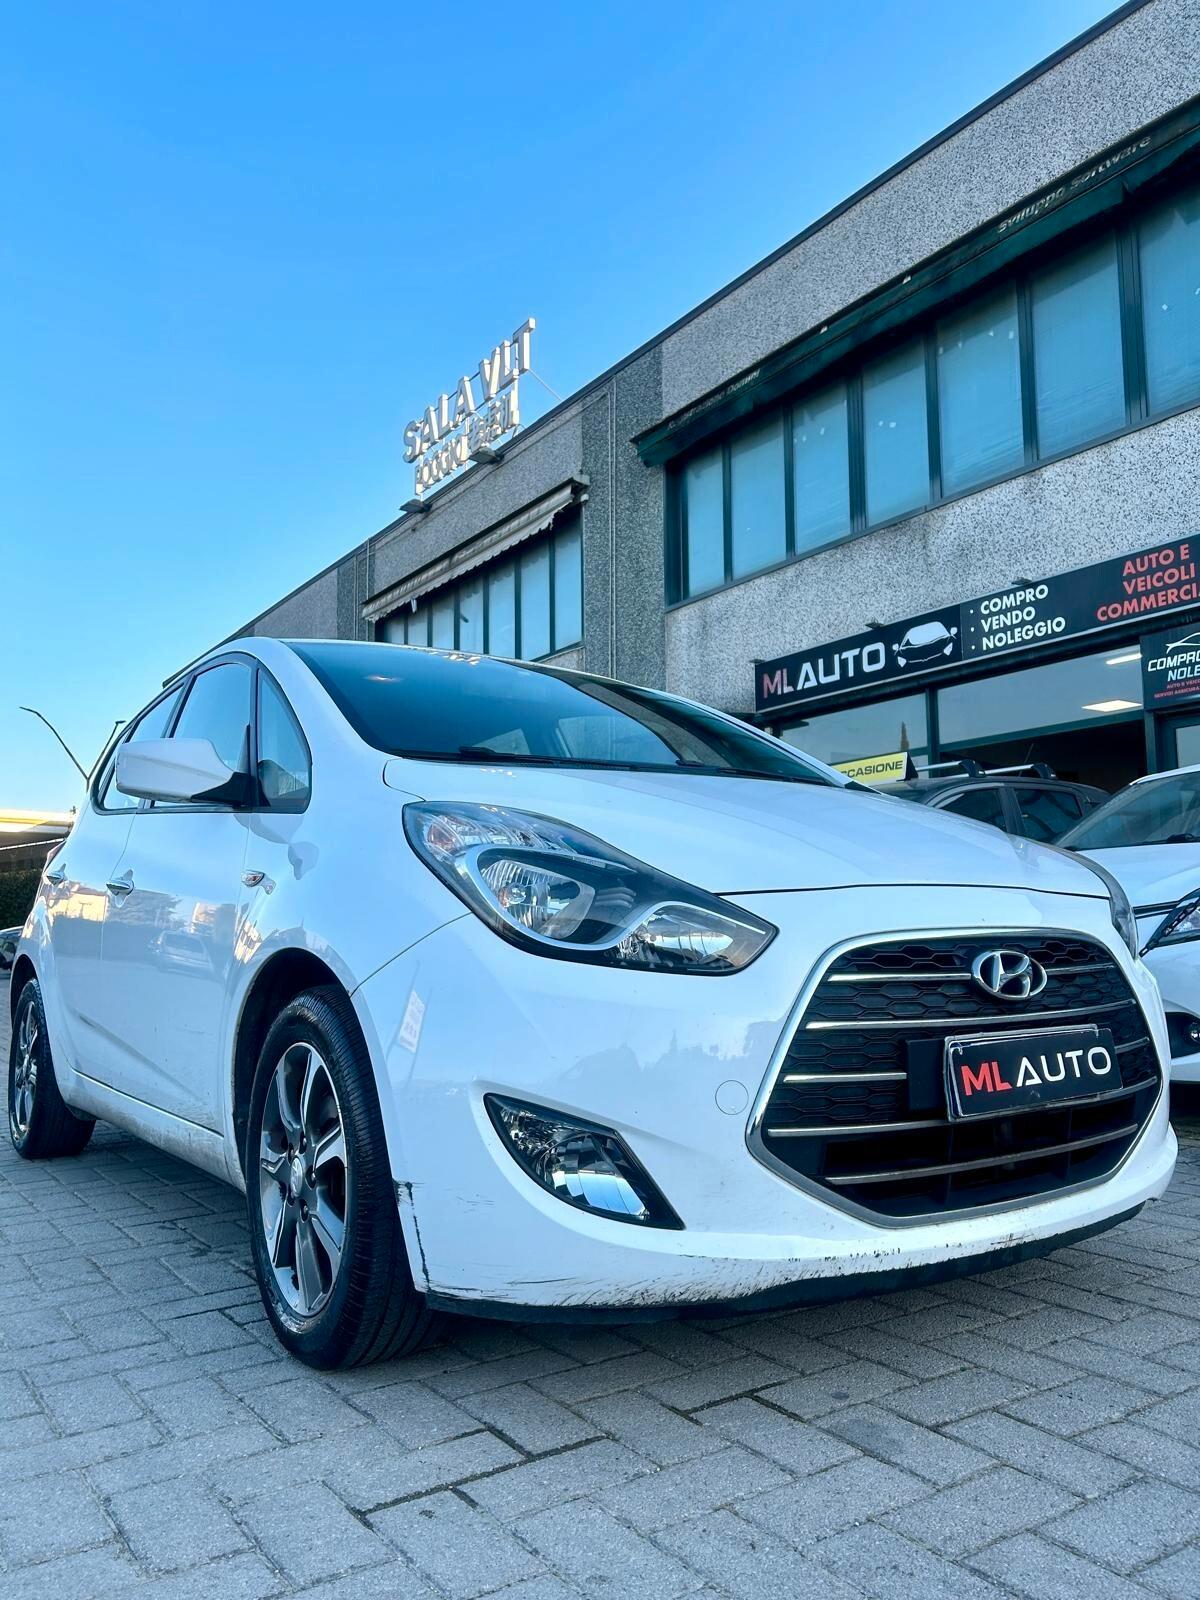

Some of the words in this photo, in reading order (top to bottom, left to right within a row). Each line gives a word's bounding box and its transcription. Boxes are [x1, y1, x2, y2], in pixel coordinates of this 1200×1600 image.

[402, 376, 475, 463] SALA
[1122, 549, 1175, 576] AUTO
[1179, 543, 1190, 561] E
[1123, 562, 1196, 595] VEICOLI
[980, 584, 1049, 615] COMPRO
[1096, 582, 1200, 621] COMMERCI
[980, 606, 1036, 633] VENDO
[982, 616, 1066, 651] NOLEGGIO
[841, 760, 903, 778] CASIONE
[960, 1061, 1012, 1097] ML
[1016, 1046, 1112, 1088] AUTO
